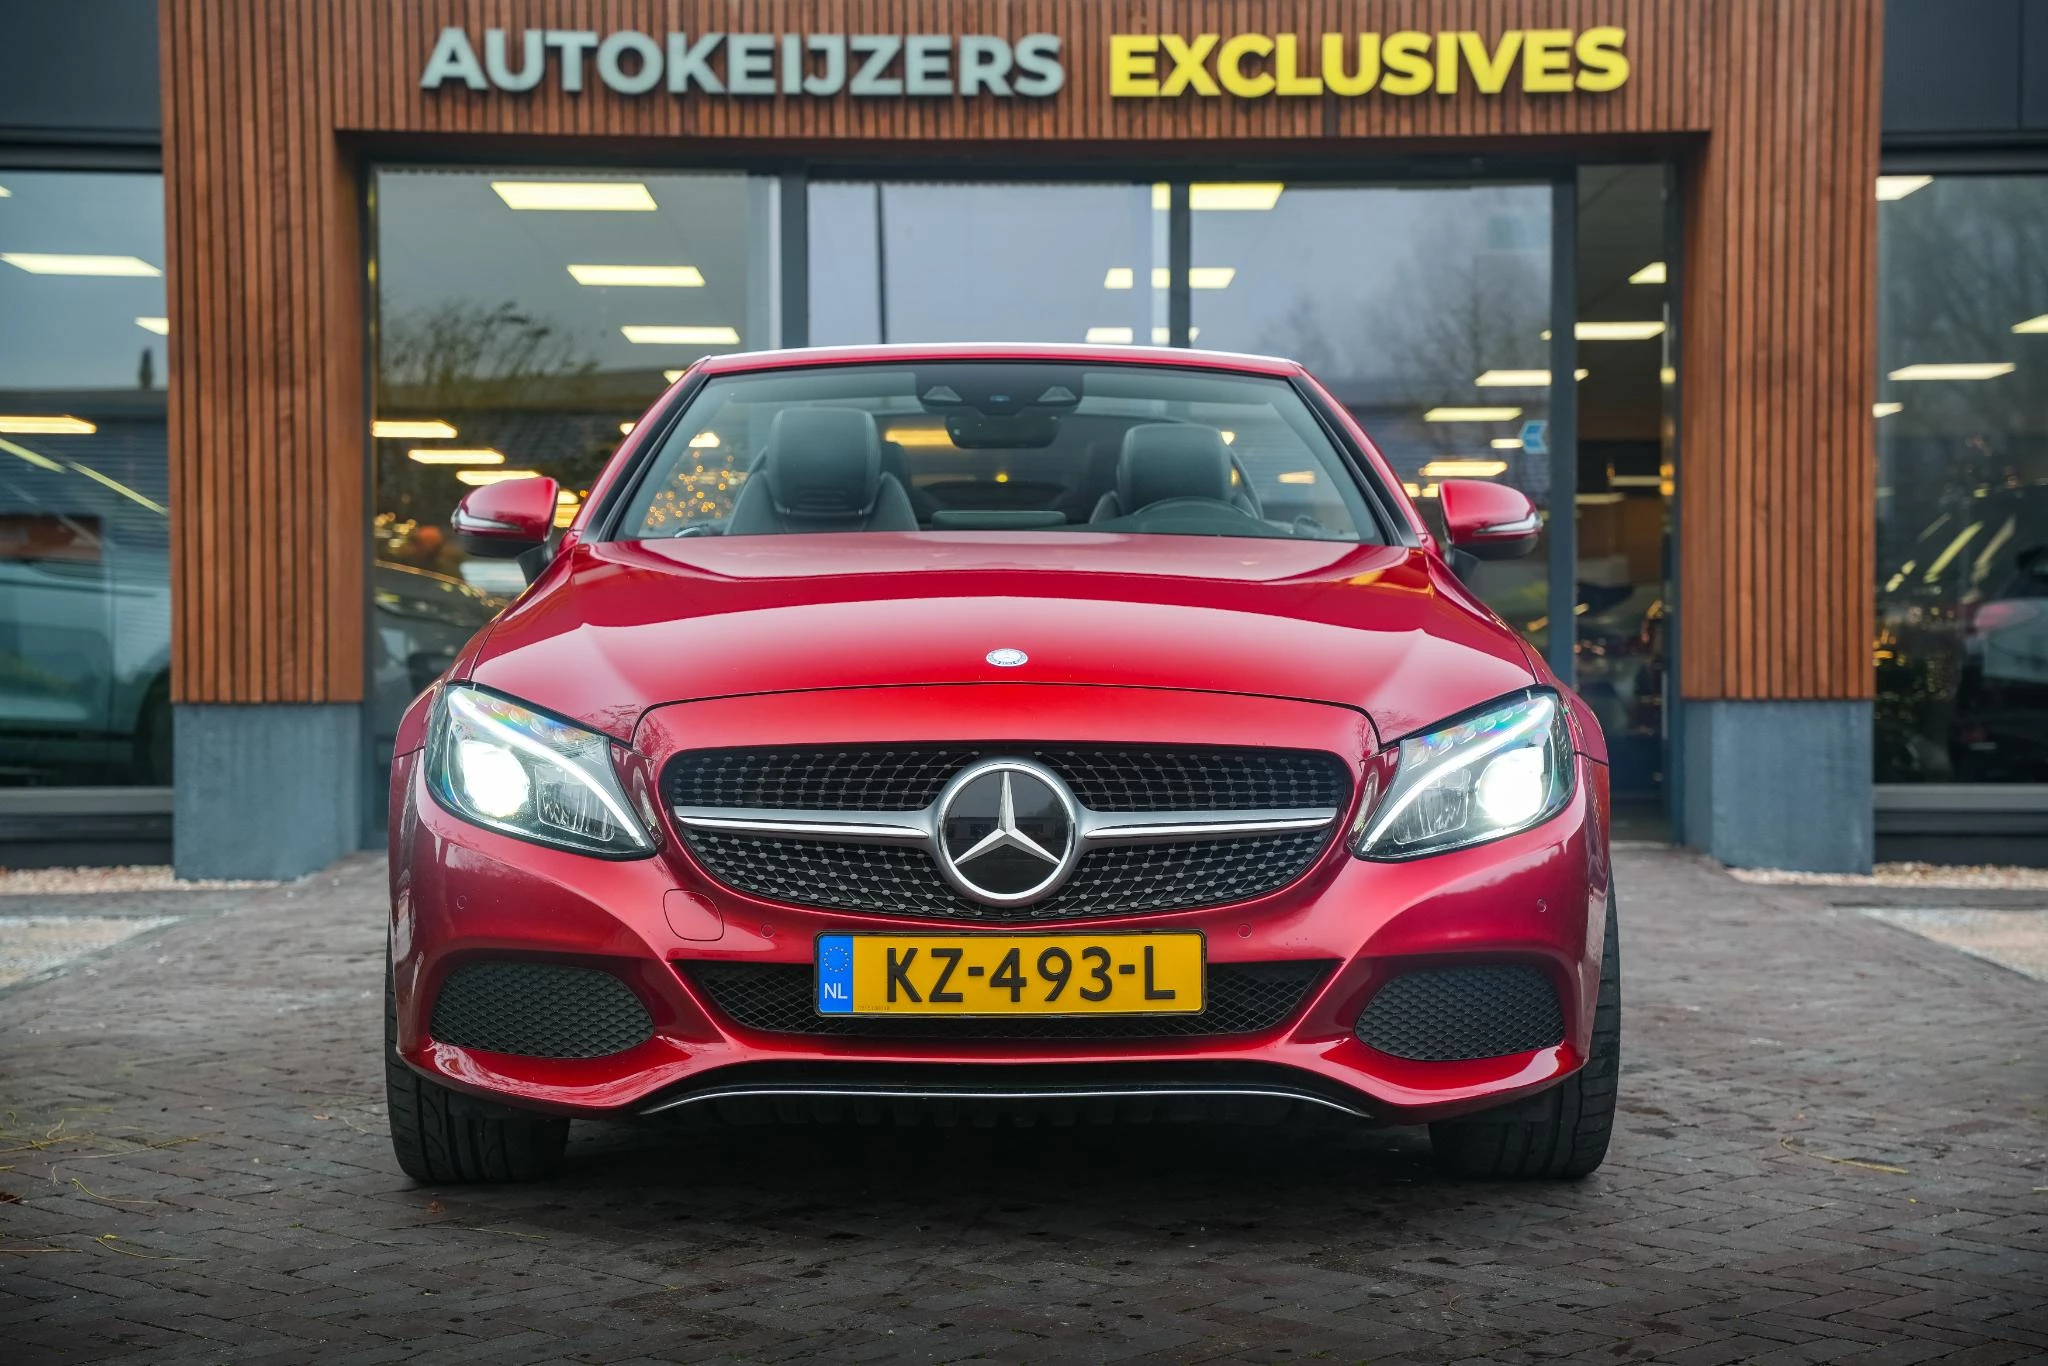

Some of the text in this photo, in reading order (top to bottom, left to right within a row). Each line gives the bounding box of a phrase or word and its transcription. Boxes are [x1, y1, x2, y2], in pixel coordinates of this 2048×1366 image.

[420, 26, 1630, 98] AUTOKEIJZERS EXCLUSIVES
[824, 983, 848, 999] NL
[886, 946, 1176, 1002] KZ-493-L
